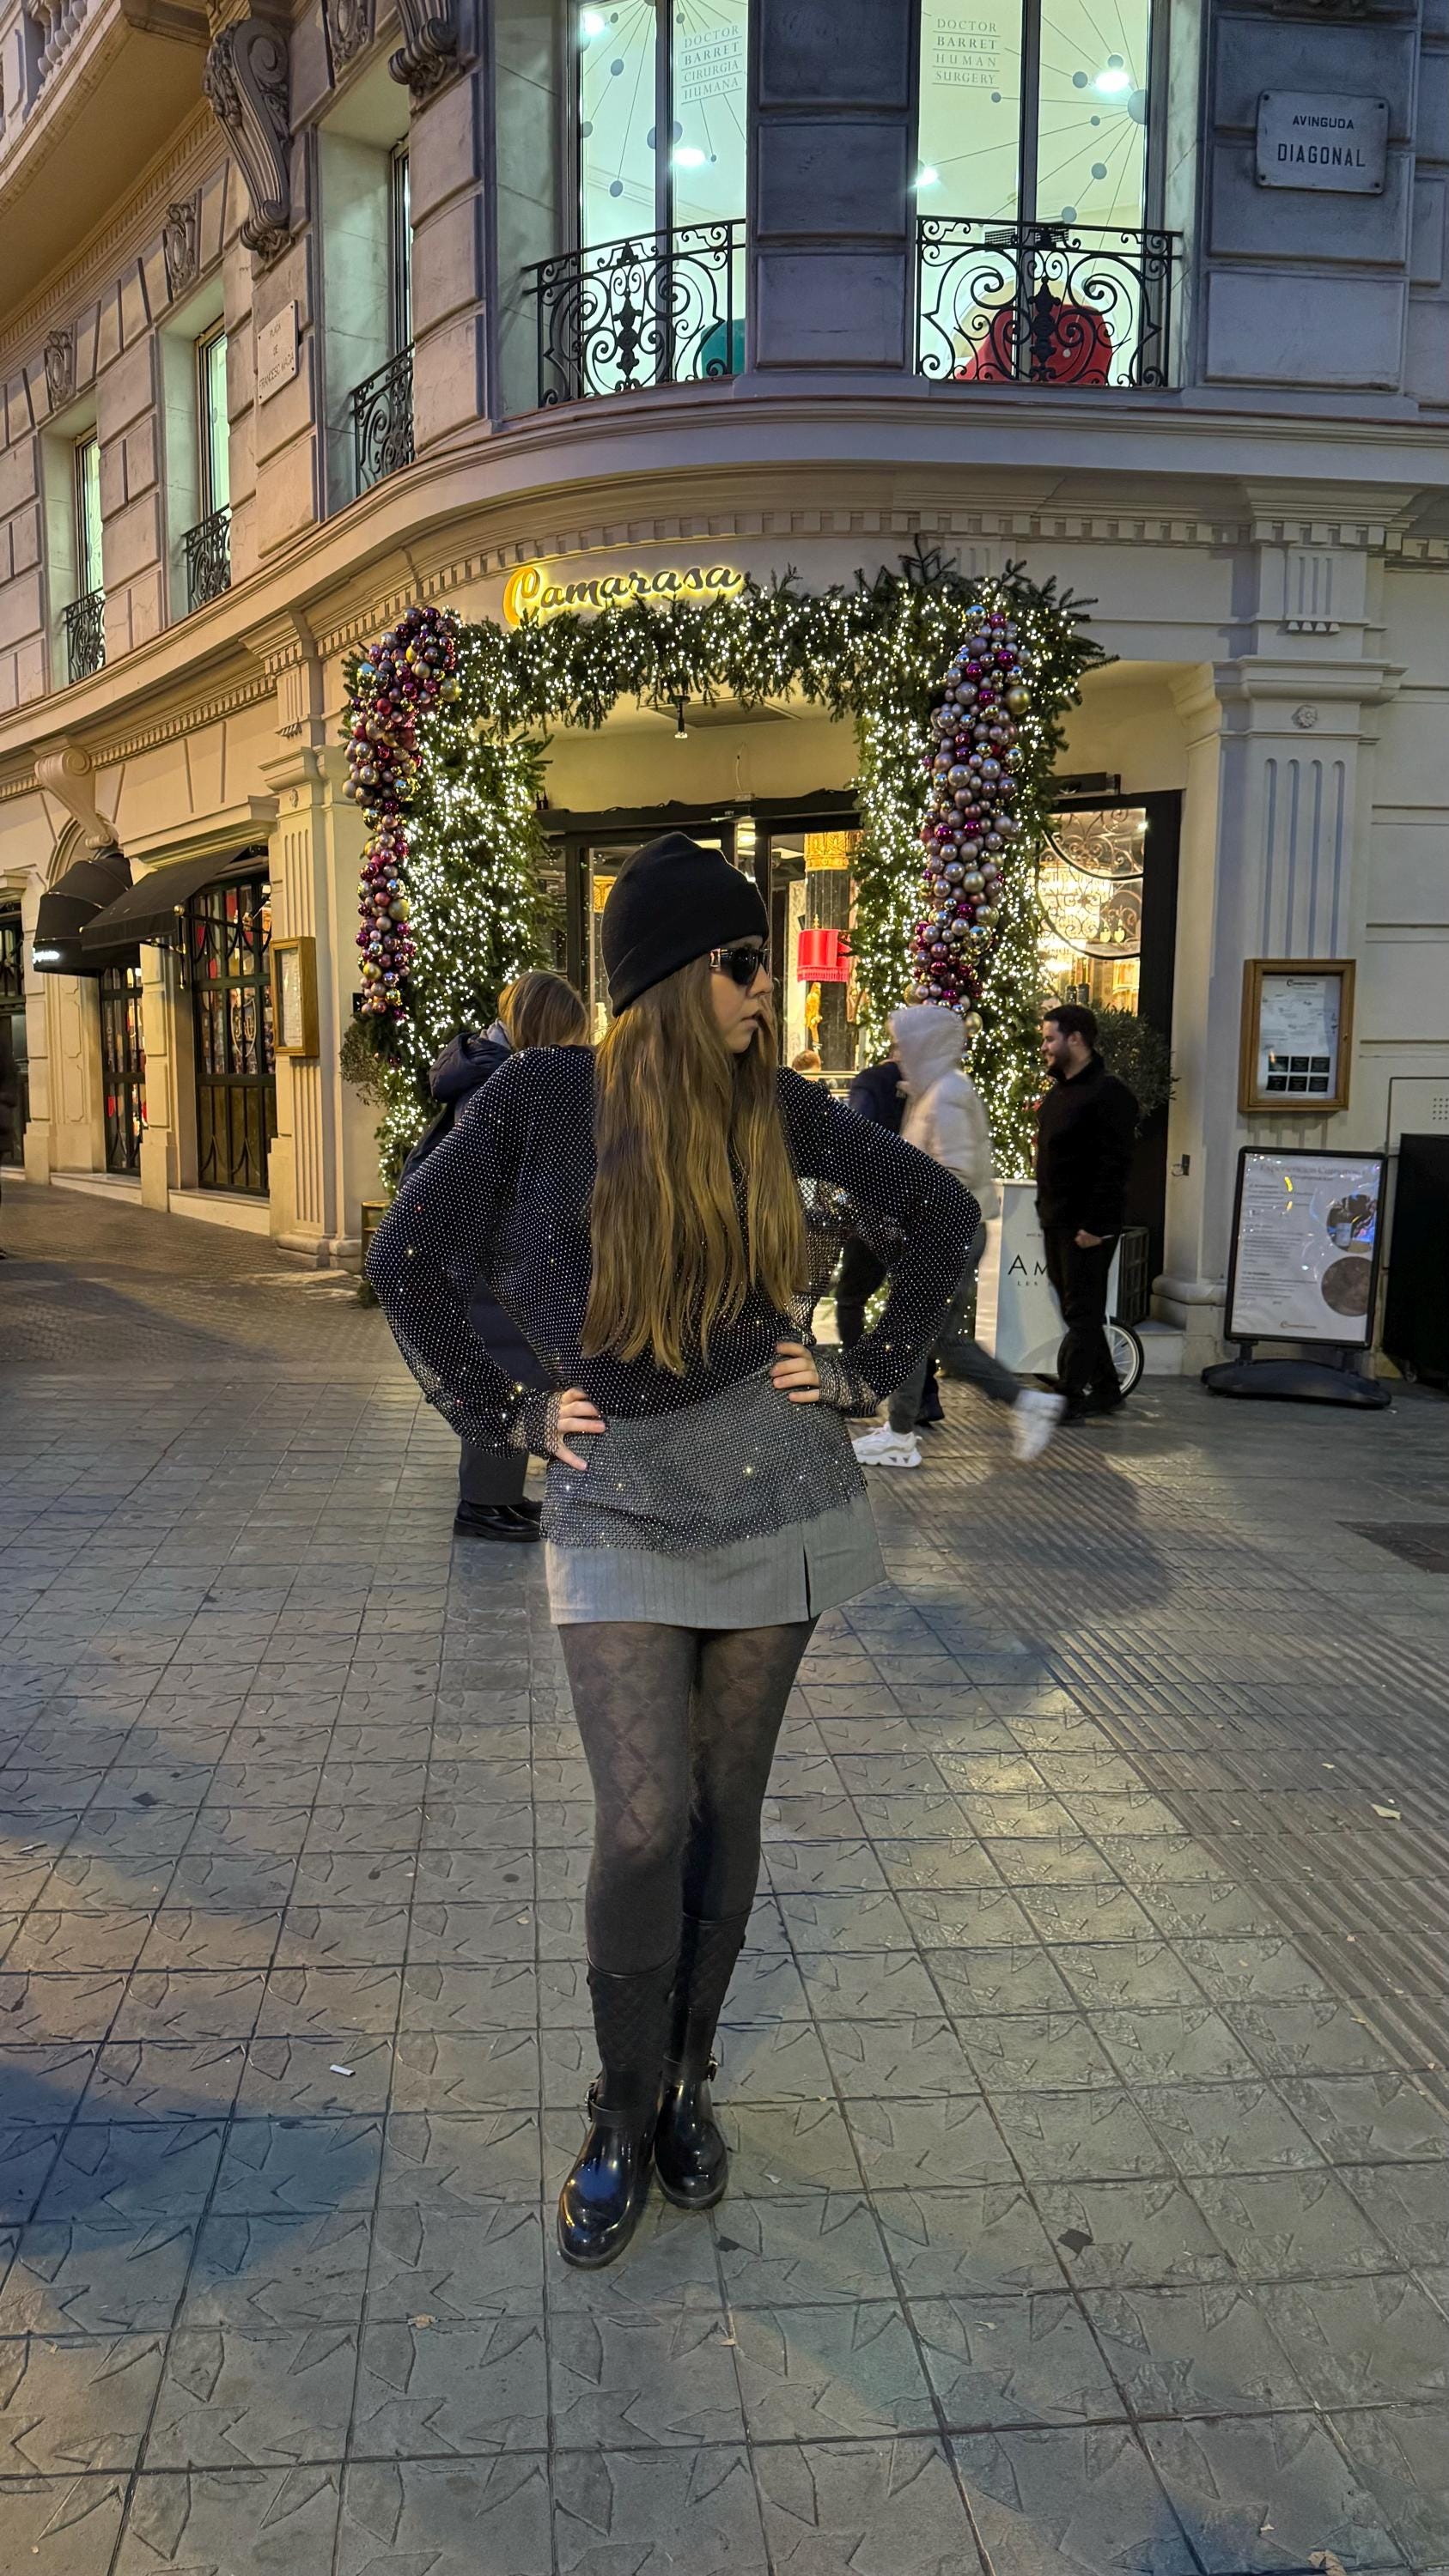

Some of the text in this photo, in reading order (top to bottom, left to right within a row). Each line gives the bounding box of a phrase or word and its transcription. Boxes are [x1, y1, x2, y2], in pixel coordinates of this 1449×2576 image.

[685, 25, 740, 49] DOCTOR
[937, 18, 996, 33] DOCTOR
[685, 40, 740, 66] BARRET
[937, 36, 996, 50] BARRET
[684, 59, 740, 82] CIRURGIA
[936, 53, 996, 68] HUMAN
[685, 76, 740, 100] HUMANA
[935, 70, 996, 84] SURGERY
[1292, 114, 1355, 130] AVINGUDA
[1277, 143, 1366, 167] DIAGONAL
[502, 566, 742, 627] Camarasa
